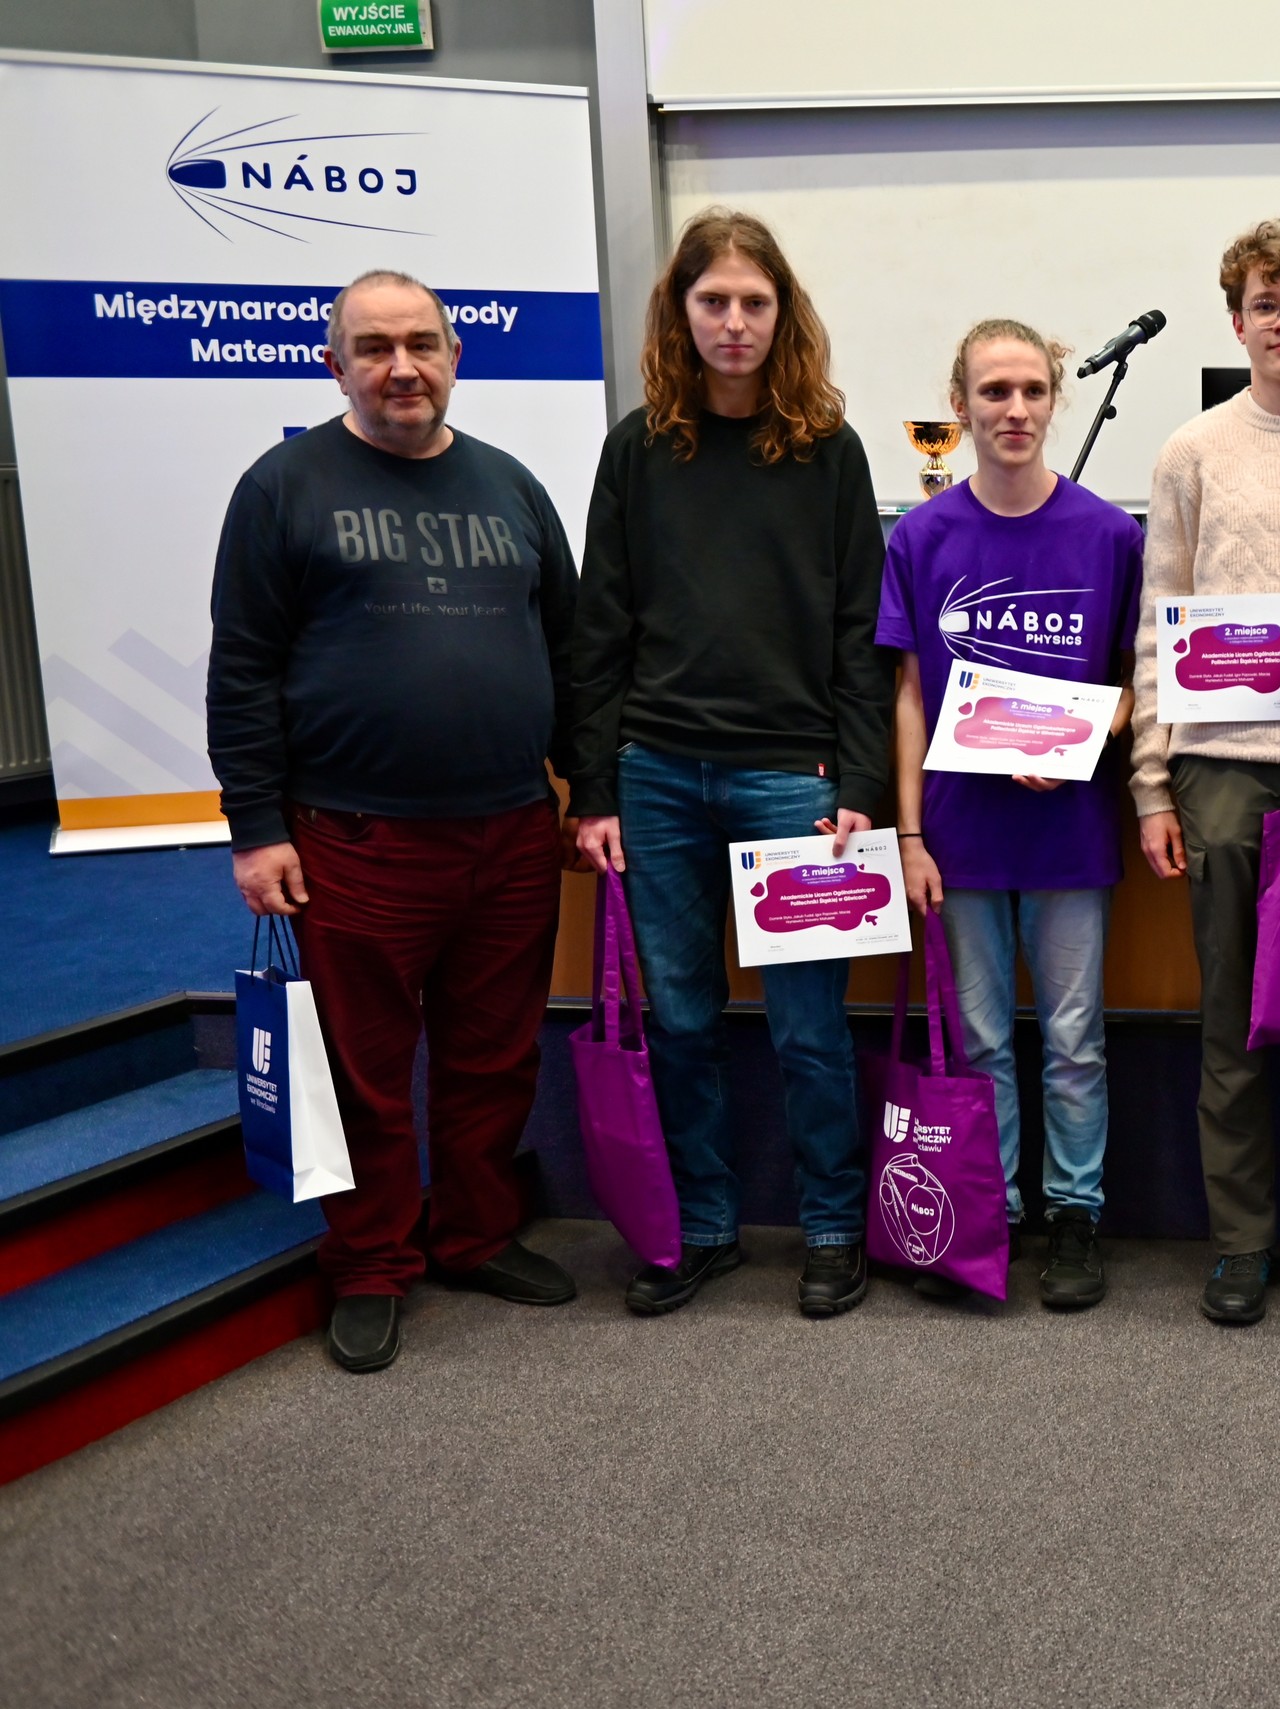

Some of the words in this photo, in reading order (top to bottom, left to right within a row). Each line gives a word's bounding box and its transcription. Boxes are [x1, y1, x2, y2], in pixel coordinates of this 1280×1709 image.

[333, 3, 405, 21] WYJŚCIE
[328, 23, 414, 36] EWAKUACYJNE
[242, 154, 417, 195] NÁBOJ
[94, 291, 334, 327] Międzynarodo
[444, 301, 518, 332] ody
[191, 338, 325, 363] Matema
[333, 508, 408, 564] BIG
[416, 511, 522, 569] STAR
[364, 603, 397, 616] Your
[438, 604, 469, 617] Your
[473, 604, 507, 617] Jeans
[976, 604, 1083, 633] NÁBOJ
[1225, 628, 1232, 636] 2.
[1234, 627, 1267, 636] miejsce
[1026, 634, 1082, 646] PHYSICS
[1011, 701, 1019, 709] 2.
[1020, 703, 1052, 713] miejsce
[802, 869, 810, 877] 2.
[811, 867, 845, 877] miejsce
